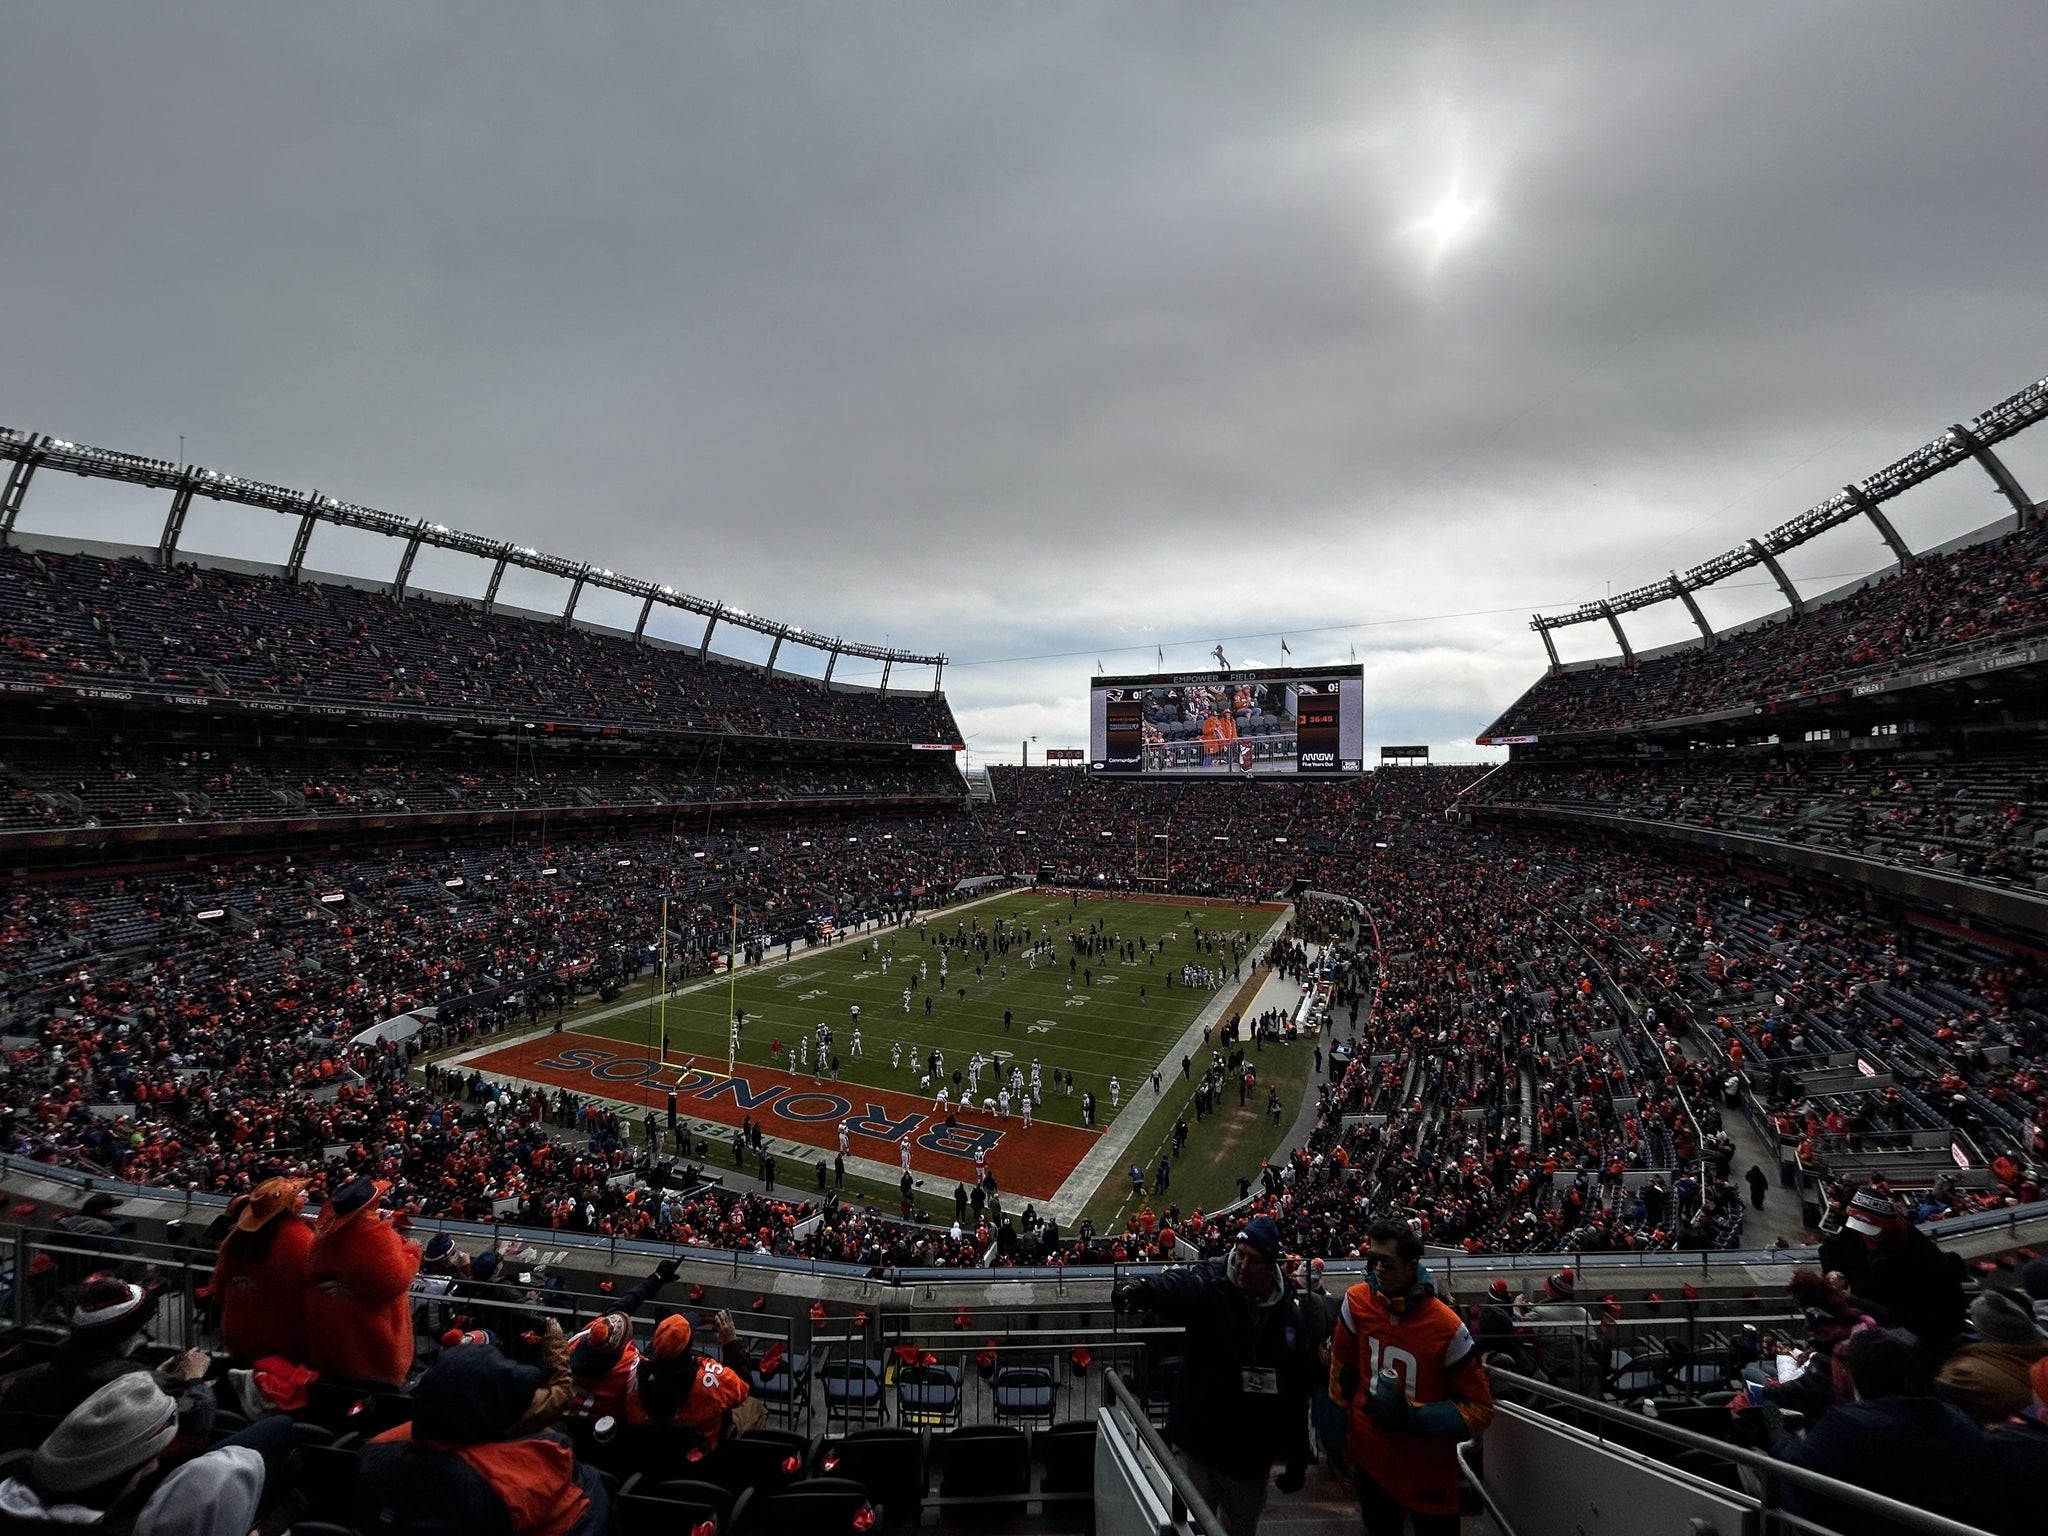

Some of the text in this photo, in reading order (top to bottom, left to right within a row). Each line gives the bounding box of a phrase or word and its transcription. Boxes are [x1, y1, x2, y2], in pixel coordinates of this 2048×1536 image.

[1995, 652, 2027, 668] MANNING
[1173, 672, 1256, 684] EMPOWER FIELD
[1936, 667, 1961, 679] THOMAS
[10, 683, 44, 693] SMITH
[1857, 683, 1879, 696] BOWLEN
[88, 690, 132, 700] 21 MINGO
[175, 697, 209, 706] REEVES
[260, 703, 285, 711] LYNCH
[378, 711, 400, 719] BAILEY
[1309, 715, 1334, 723] 36:45
[1302, 753, 1334, 761] ARROW
[797, 989, 828, 1001] 20
[1064, 994, 1092, 1007] 30
[1026, 1019, 1057, 1034] 20
[533, 1048, 1008, 1161] BRONCOS
[693, 1122, 776, 1150] TKES
[1368, 1335, 1417, 1402] 10
[702, 1361, 724, 1389] 95
